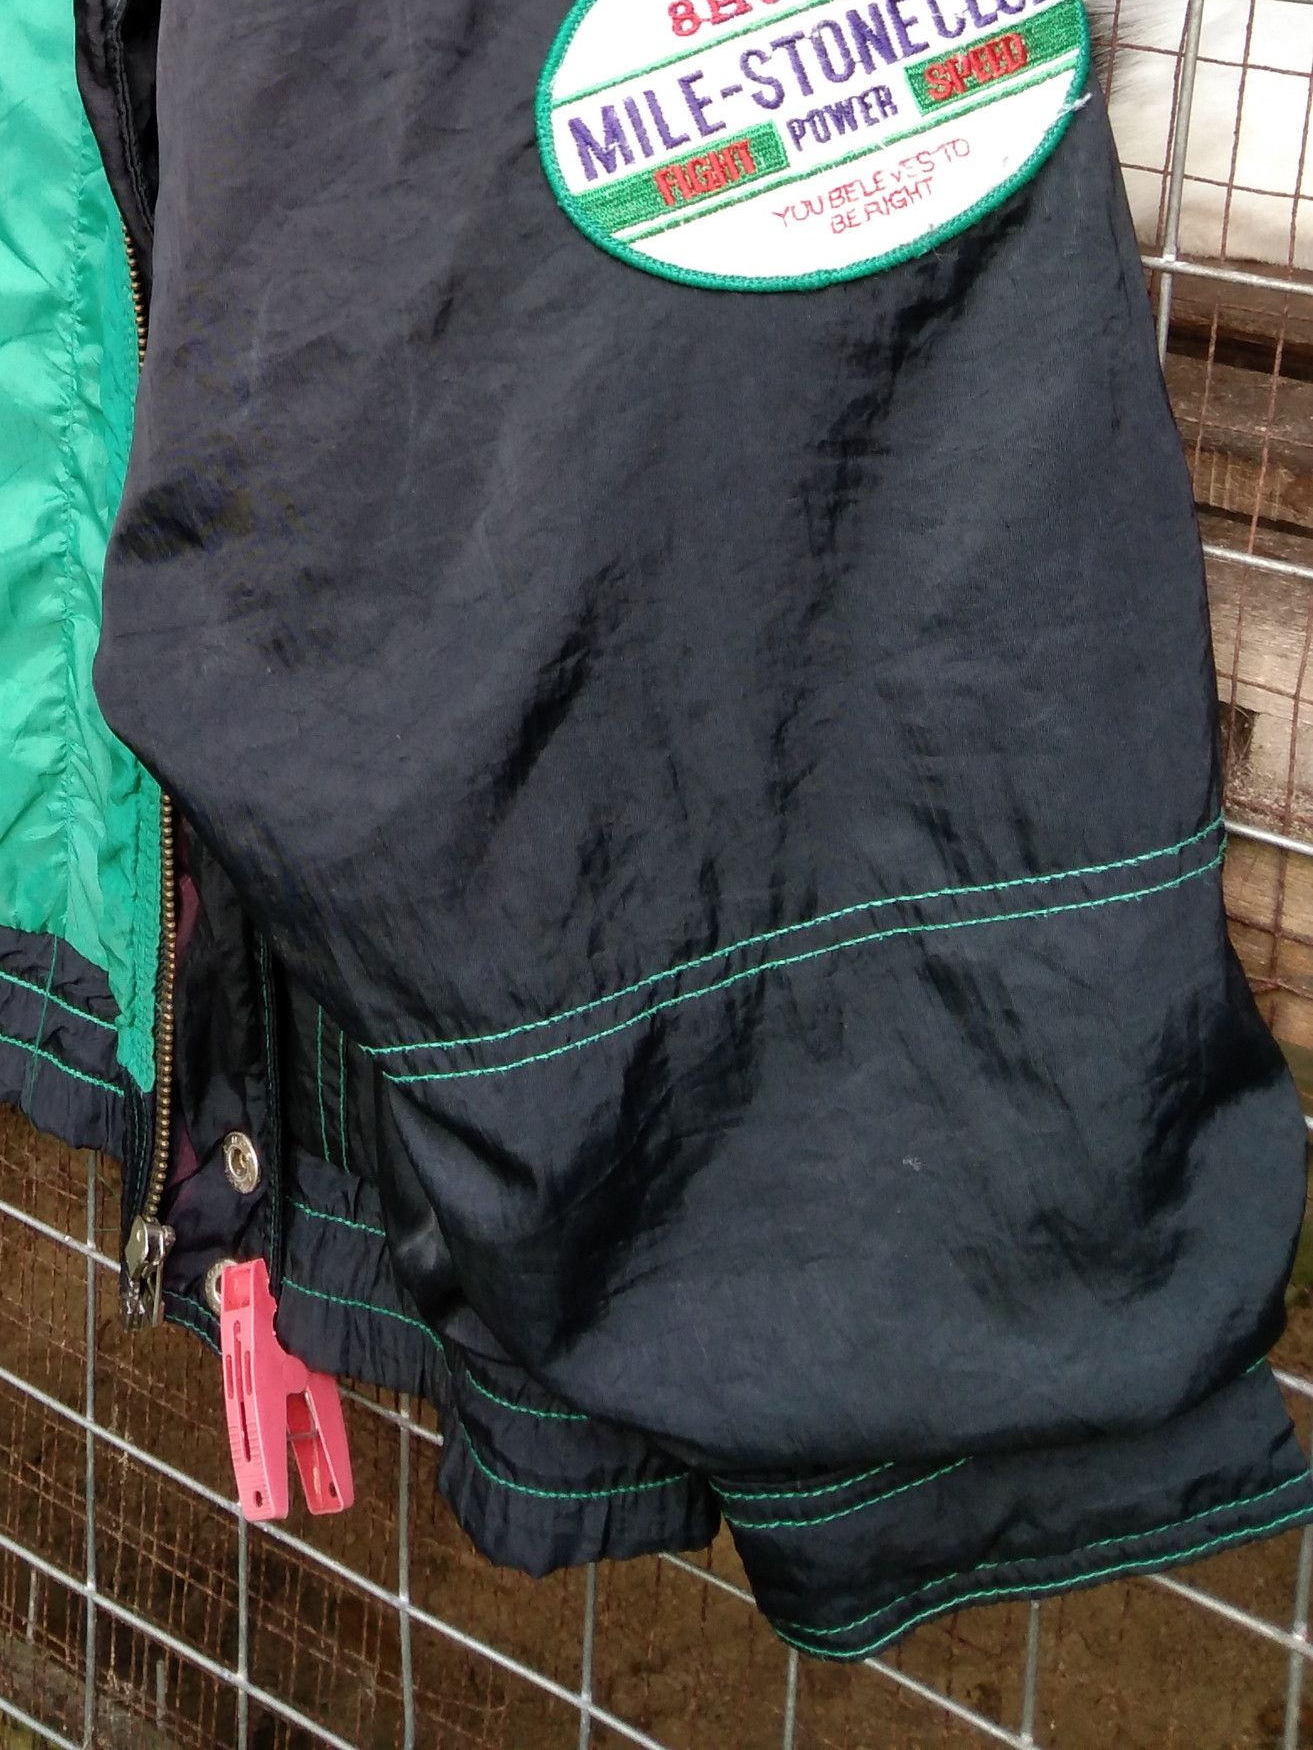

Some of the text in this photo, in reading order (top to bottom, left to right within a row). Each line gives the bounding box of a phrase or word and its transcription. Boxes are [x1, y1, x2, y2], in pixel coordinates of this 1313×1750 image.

[653, 32, 1029, 207] FIGHT POWER SPEED
